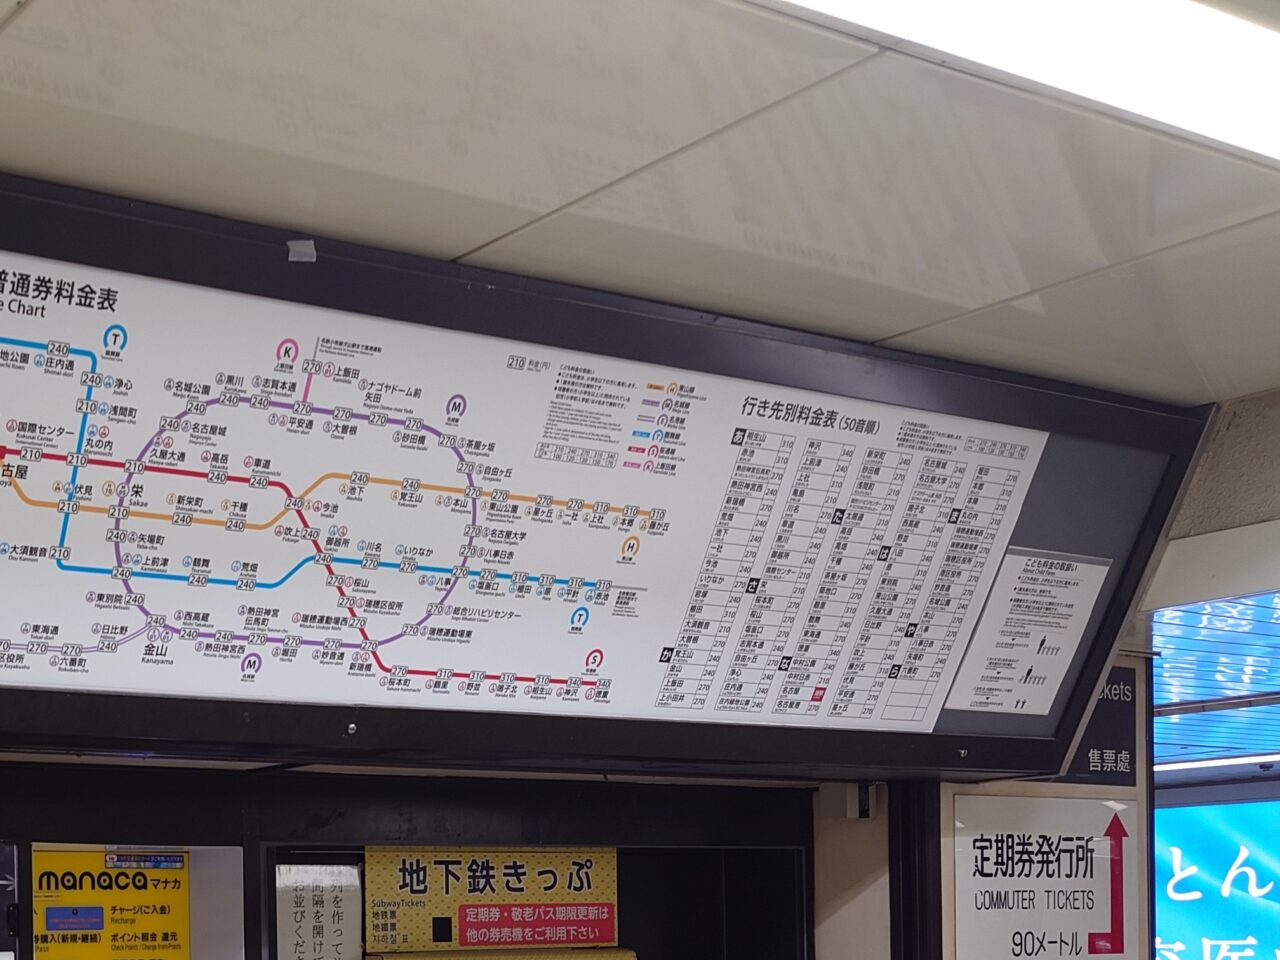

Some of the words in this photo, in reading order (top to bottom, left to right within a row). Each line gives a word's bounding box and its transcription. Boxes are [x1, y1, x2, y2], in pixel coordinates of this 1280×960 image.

[8, 298, 47, 318] Chart
[45, 357, 75, 371] 庄内通
[225, 374, 244, 387] 黒川
[334, 367, 361, 379] 上飯田
[112, 378, 133, 391] 浄心
[174, 380, 212, 396] 名城公園
[262, 378, 297, 393] 志賀本通
[367, 380, 422, 400] ナゴヤドーム前
[107, 404, 138, 419] 浅間町
[17, 421, 76, 438] 国際センター
[191, 421, 227, 437] 名古屋城
[331, 423, 358, 436] 大曽根
[85, 437, 114, 451] 丸の内
[149, 448, 186, 462] 久屋大通
[130, 483, 144, 498] 栄
[176, 495, 204, 508] 新栄町
[230, 500, 249, 513] 千種
[322, 502, 339, 514] 今池
[488, 502, 519, 515] 東山公園
[136, 532, 166, 546] 矢場町
[9, 545, 48, 559] 大須観音
[403, 545, 434, 558] いりなか
[141, 554, 169, 569] 上前津
[452, 605, 521, 620] 総合リハビリセンター
[31, 624, 60, 637] 東海通
[101, 624, 129, 637] 日比野
[143, 643, 168, 658] 金山
[204, 642, 246, 655] 熱田神宮西
[58, 656, 87, 669] 六番町
[141, 656, 174, 666] Kanayama
[1088, 748, 1131, 773] 售票處
[972, 834, 1095, 880] 定期券発行所
[38, 871, 148, 891] manaca
[150, 878, 181, 890] マナカ
[398, 858, 594, 896] 地下鉄きっぷ
[1166, 846, 1275, 901] とん
[974, 890, 1036, 911] COMMUTER
[1045, 889, 1095, 911] TICKETS
[465, 905, 610, 922] 定期券・敬老パス期限更新は
[465, 926, 600, 942] 他の券売機をご利用下さい
[1011, 931, 1082, 958] 90メートル
